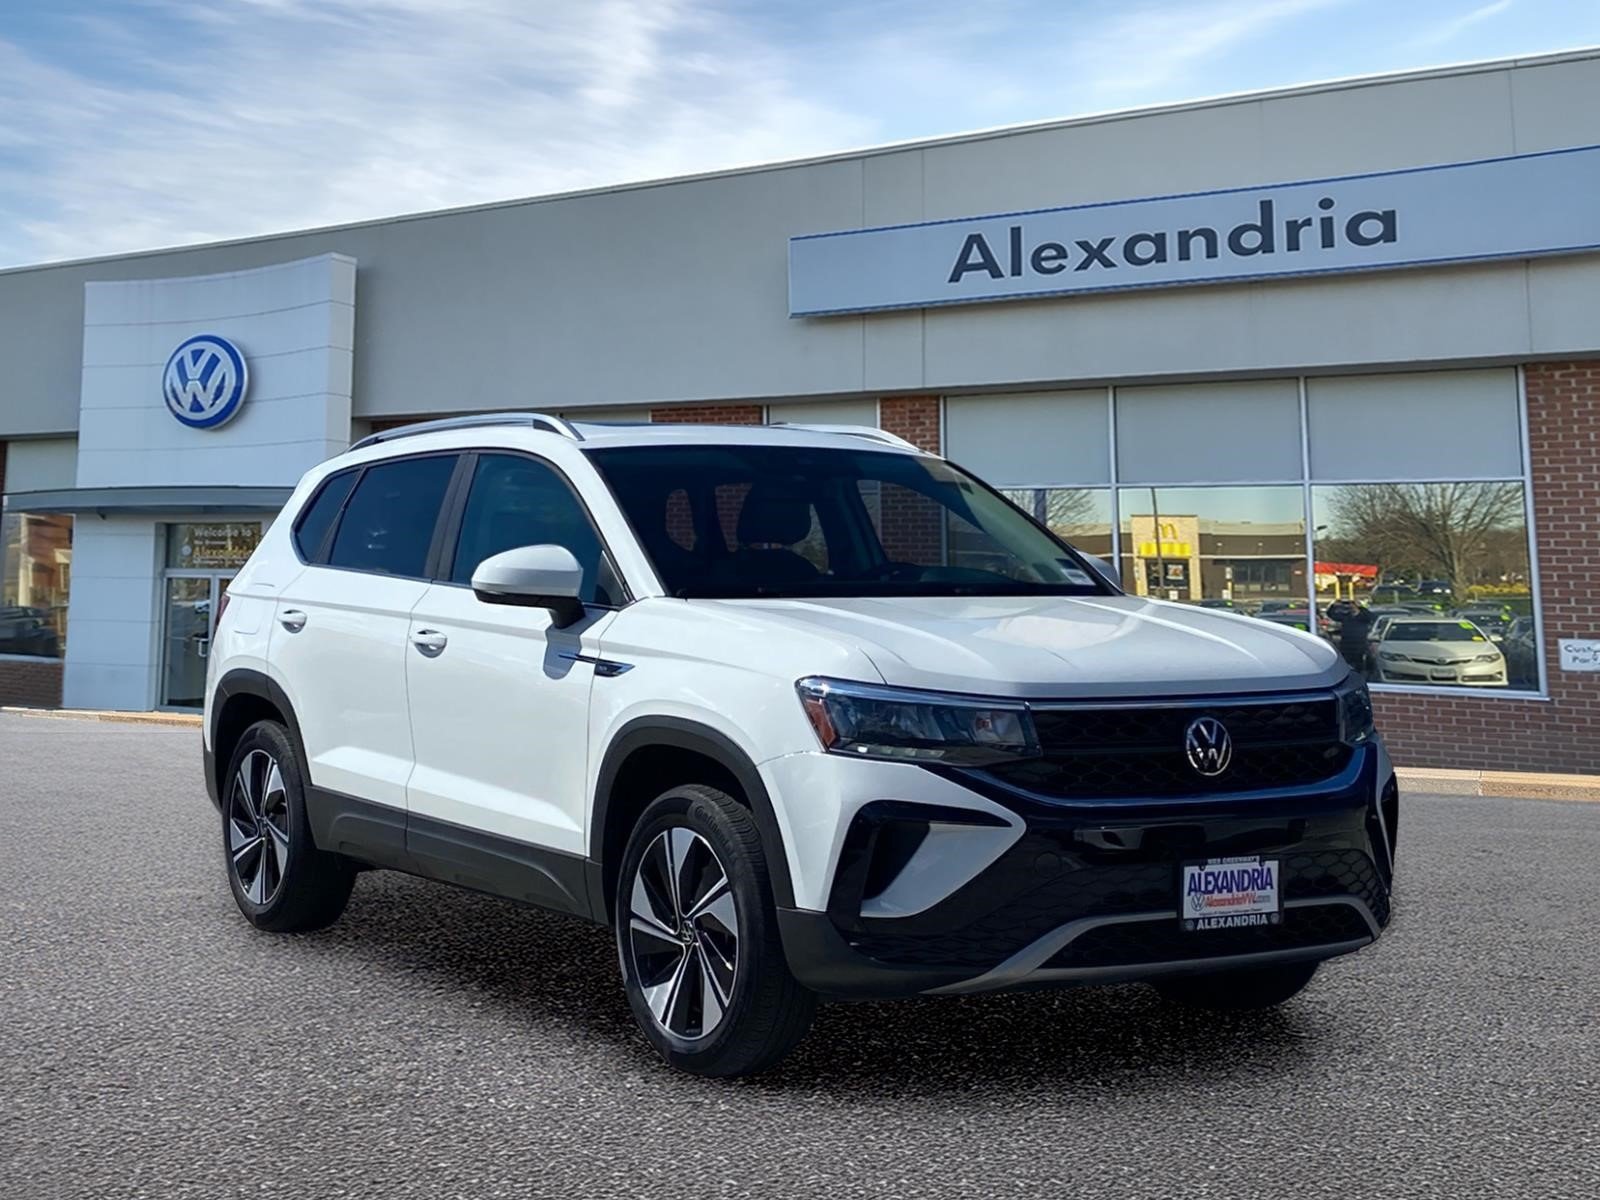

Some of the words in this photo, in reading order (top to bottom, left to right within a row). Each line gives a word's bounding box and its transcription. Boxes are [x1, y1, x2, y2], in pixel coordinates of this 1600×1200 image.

[947, 196, 1398, 284] Alexandria
[163, 335, 245, 428] VW
[194, 527, 239, 537] Welcome
[241, 527, 252, 537] to
[1187, 867, 1275, 896] ALEXANDRIA
[1196, 914, 1268, 930] ALEXANDRIA
